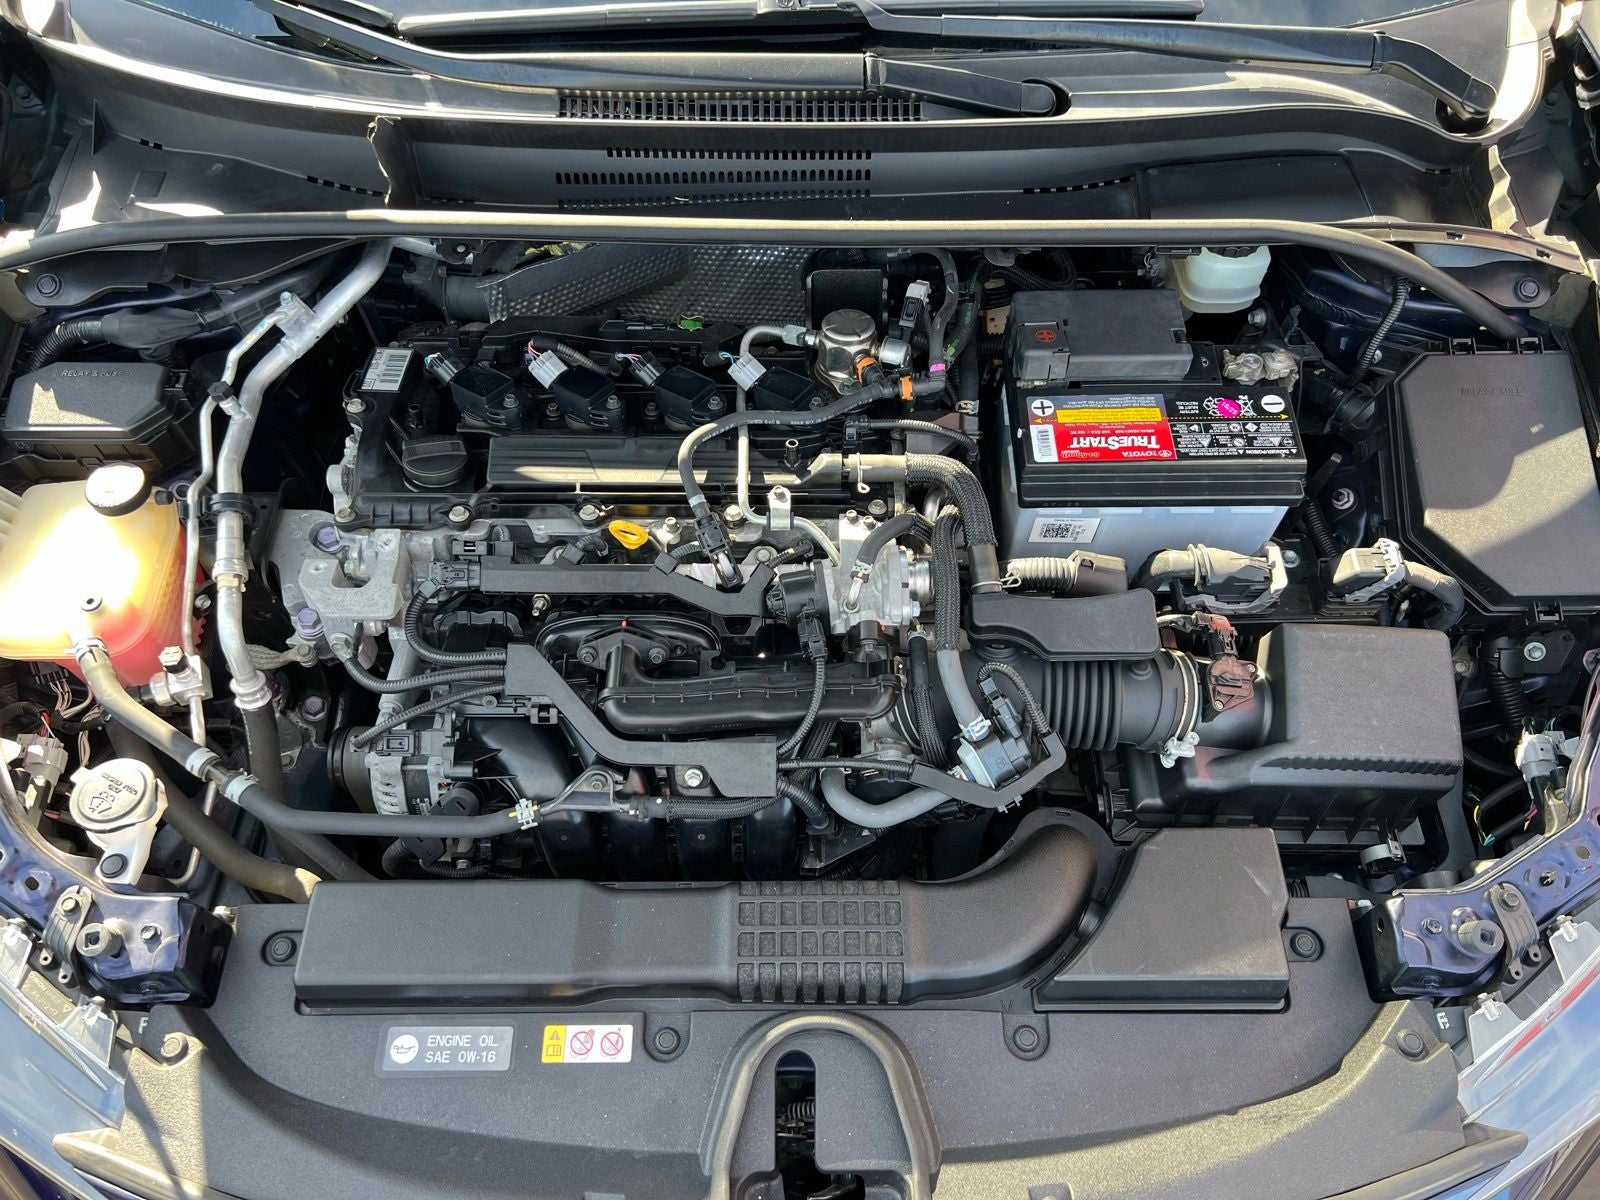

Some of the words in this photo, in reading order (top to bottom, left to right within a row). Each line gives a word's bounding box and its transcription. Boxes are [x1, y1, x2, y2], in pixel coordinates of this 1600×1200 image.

[426, 1034, 472, 1047] ENGINE
[479, 1034, 499, 1047] OIL
[424, 1051, 450, 1063] SAE
[457, 1051, 497, 1063] 0W-16
